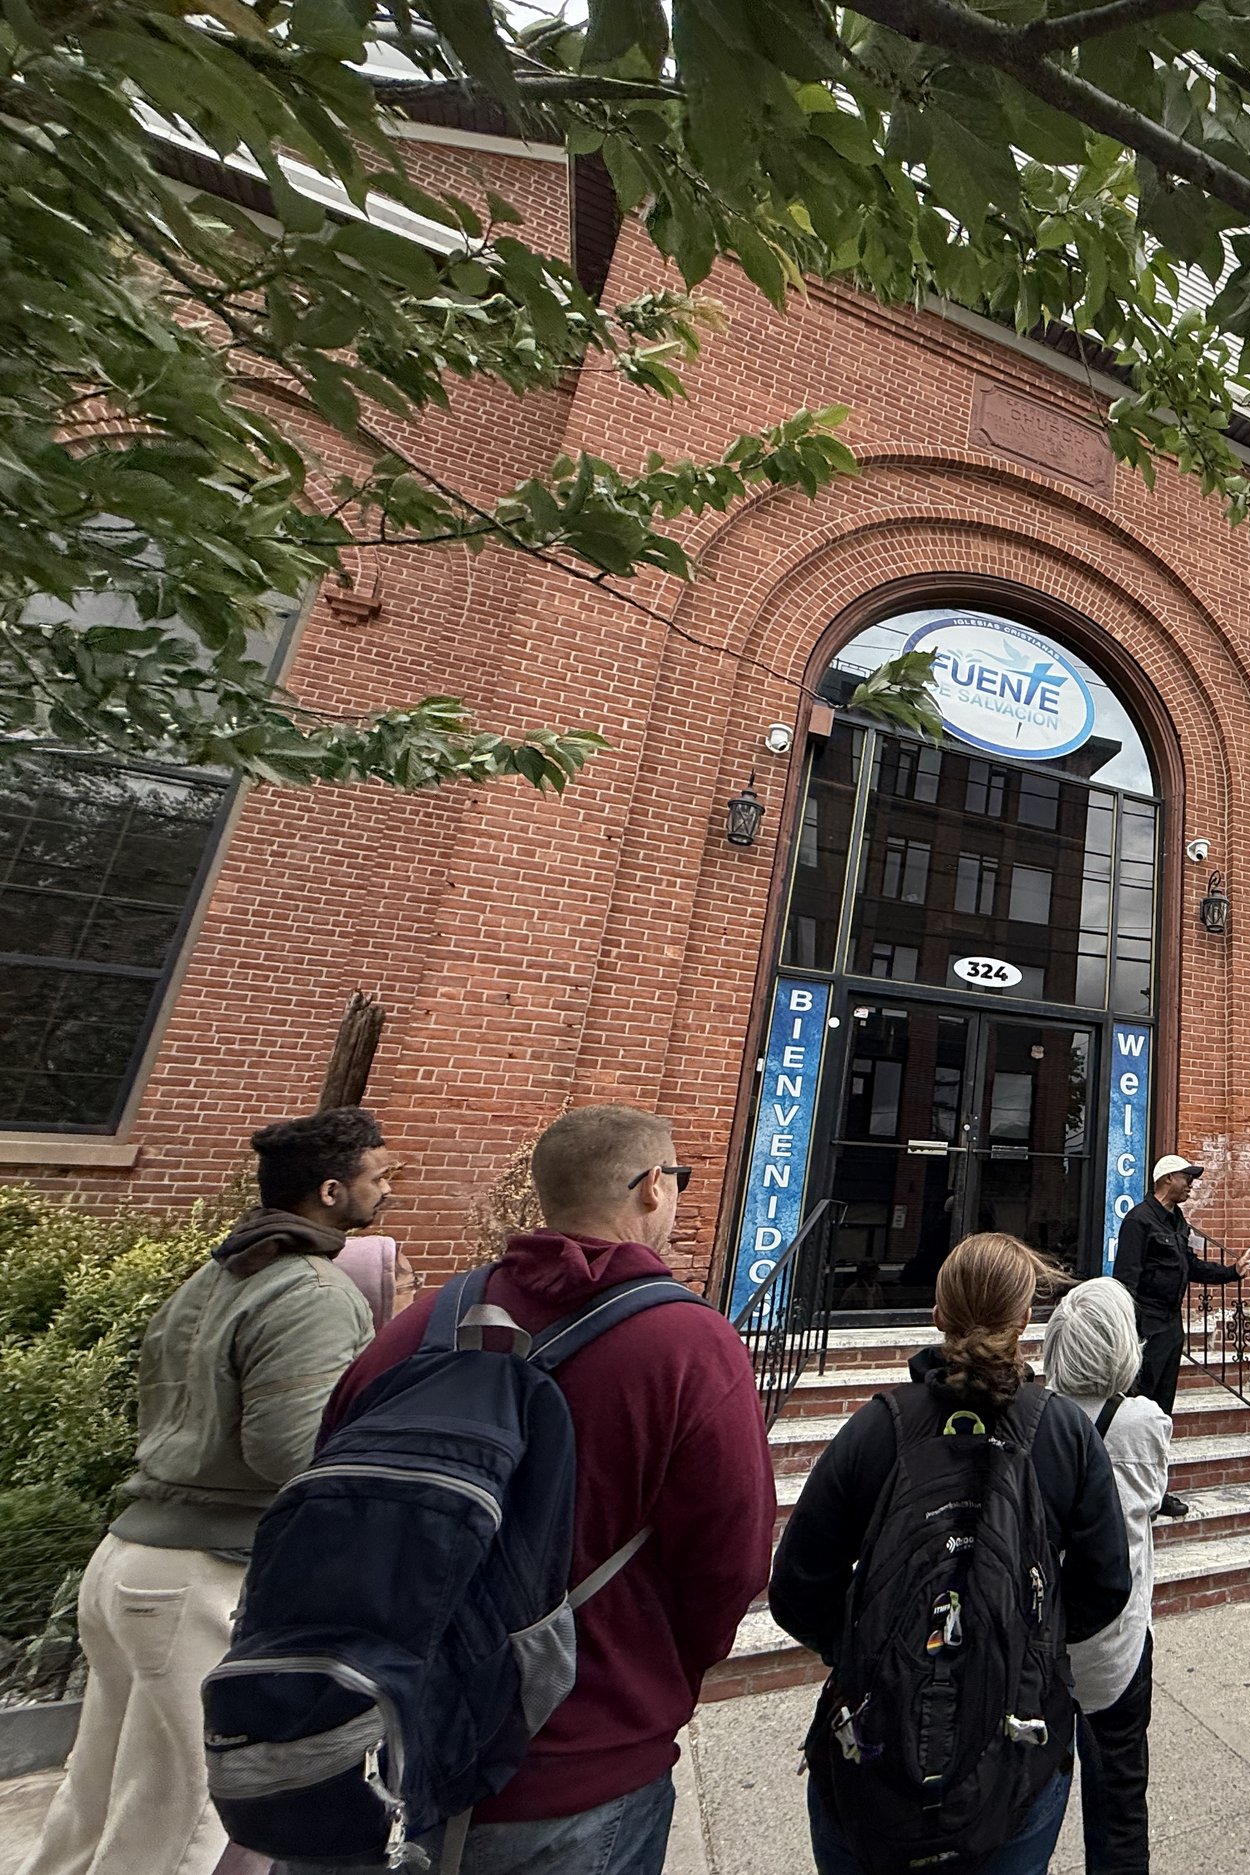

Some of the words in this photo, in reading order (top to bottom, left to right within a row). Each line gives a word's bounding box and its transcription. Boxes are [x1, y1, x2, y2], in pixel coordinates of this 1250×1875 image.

[953, 619, 1001, 630] IGLESIAS
[1003, 626, 1061, 660] CRISTIANAS
[957, 688, 1060, 731] SALVACION
[966, 961, 1008, 981] 324
